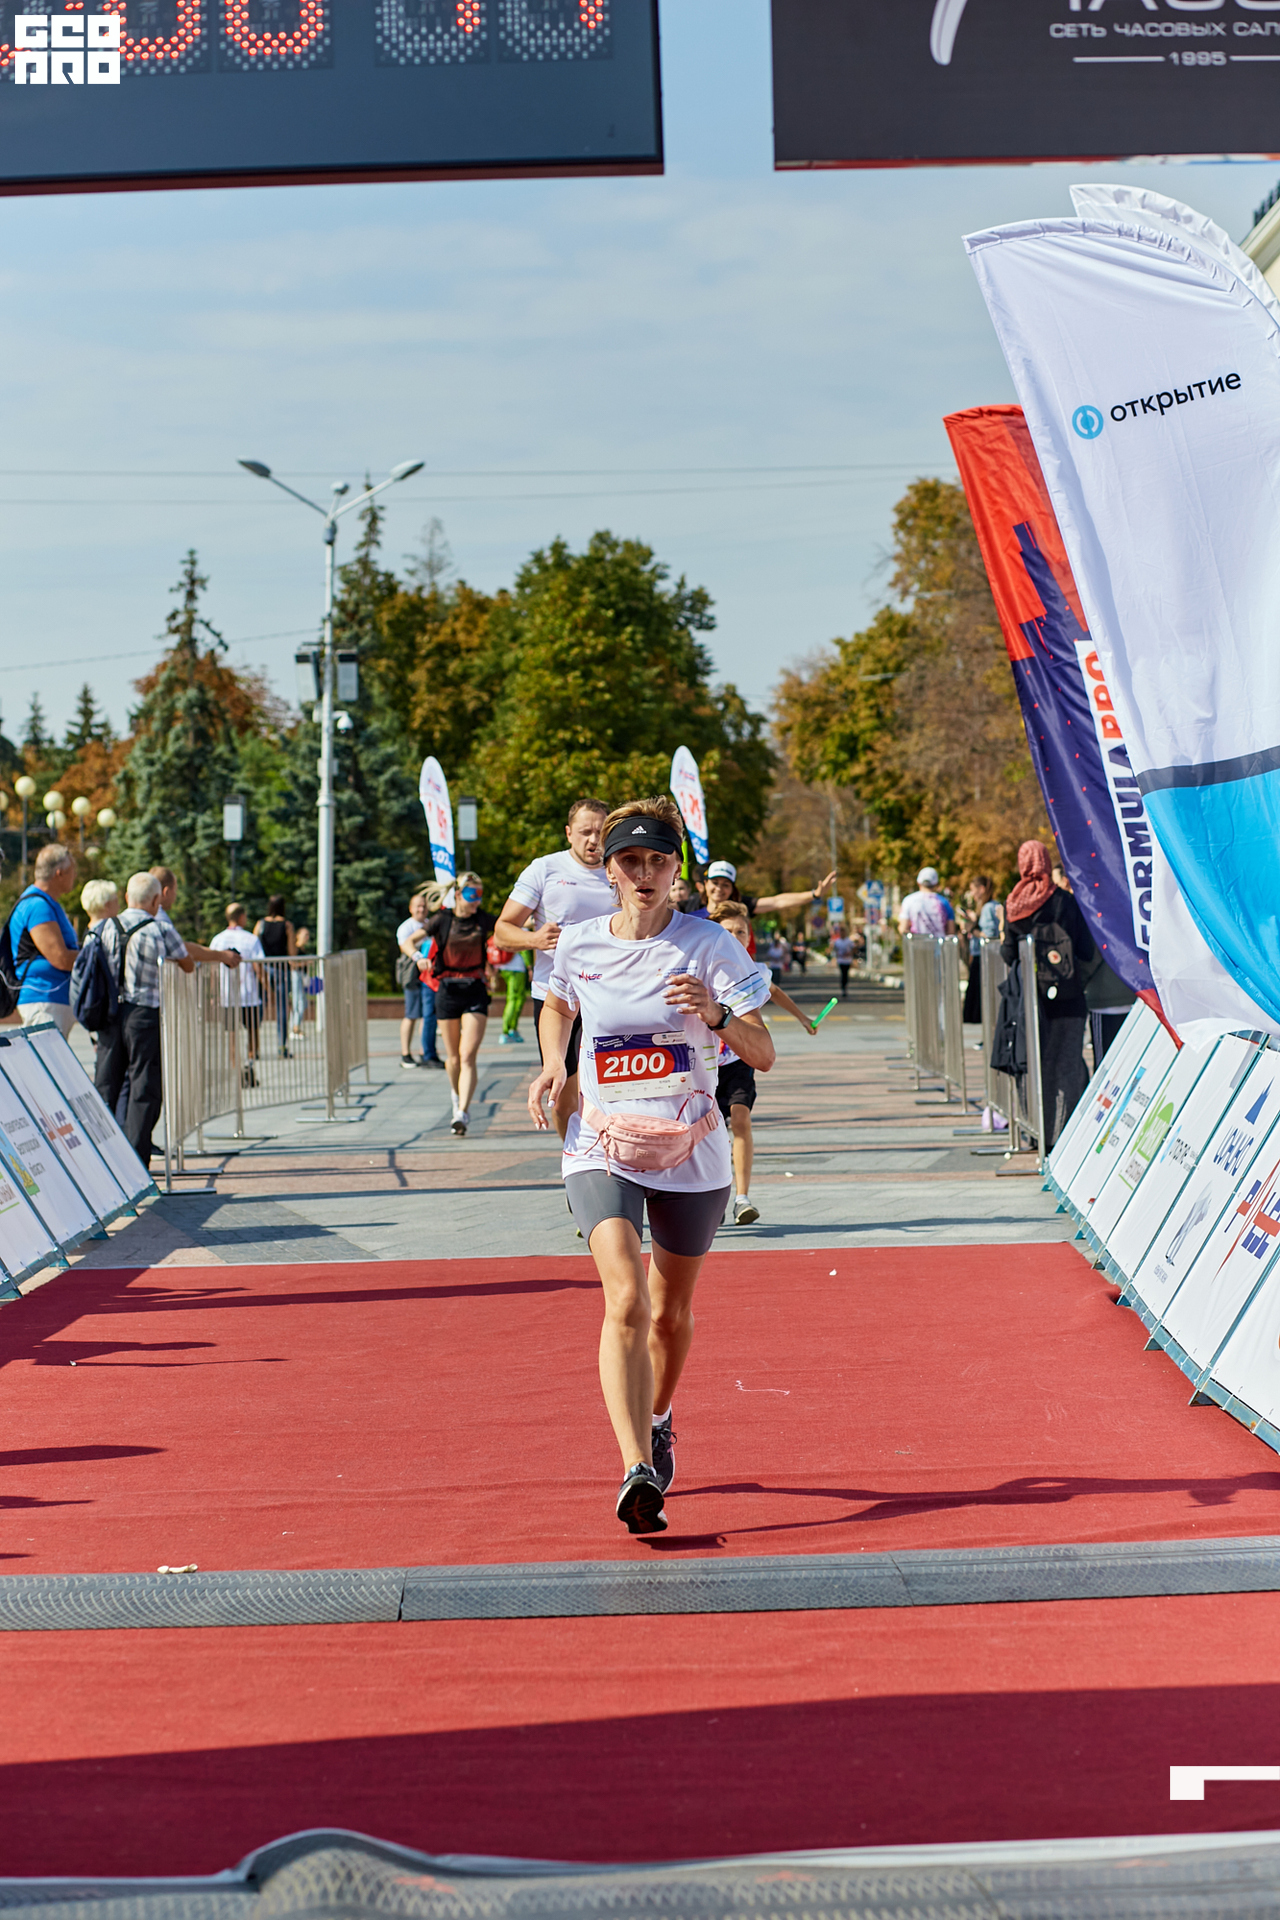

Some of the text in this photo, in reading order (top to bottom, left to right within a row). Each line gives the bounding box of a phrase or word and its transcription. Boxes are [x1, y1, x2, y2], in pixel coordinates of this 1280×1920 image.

[1049, 22, 1107, 38] СЕТЬ
[1113, 21, 1227, 37] ЧАСОВЫХ
[1168, 51, 1227, 66] 1995
[1109, 372, 1242, 422] открытие
[603, 1051, 666, 1078] 2100
